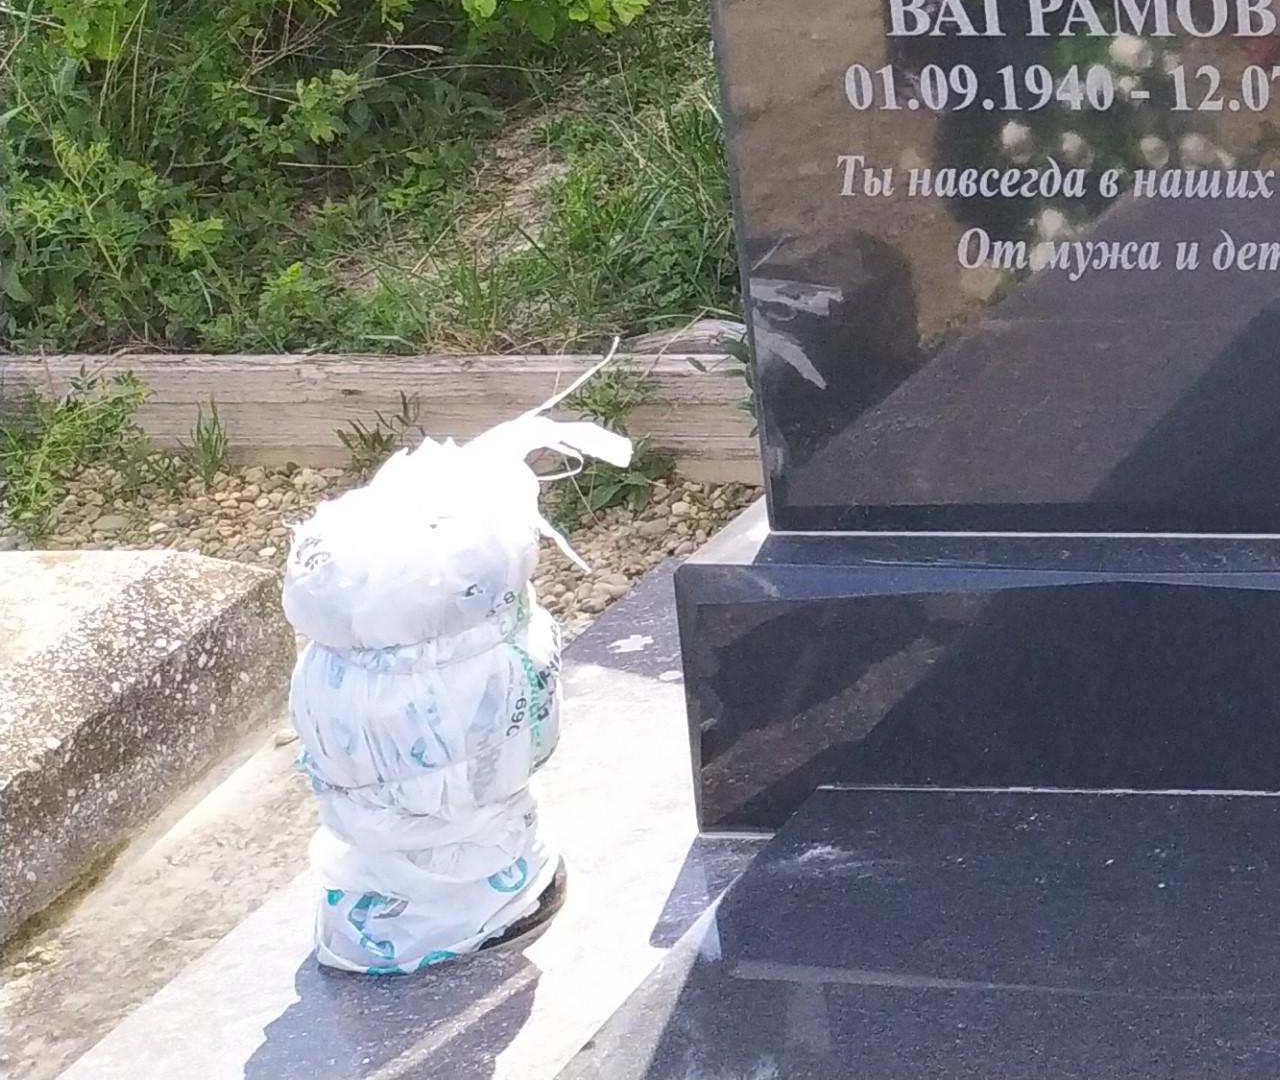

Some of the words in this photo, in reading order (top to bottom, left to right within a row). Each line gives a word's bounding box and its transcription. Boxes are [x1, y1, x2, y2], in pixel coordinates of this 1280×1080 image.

[843, 64, 1116, 113] 01.09.1940
[836, 154, 895, 198] Ты
[907, 156, 1087, 199] навсегда
[1099, 168, 1119, 198] в
[1133, 168, 1274, 199] наших
[957, 227, 1028, 270] От
[1038, 239, 1162, 282] мужа
[1175, 240, 1201, 271] и
